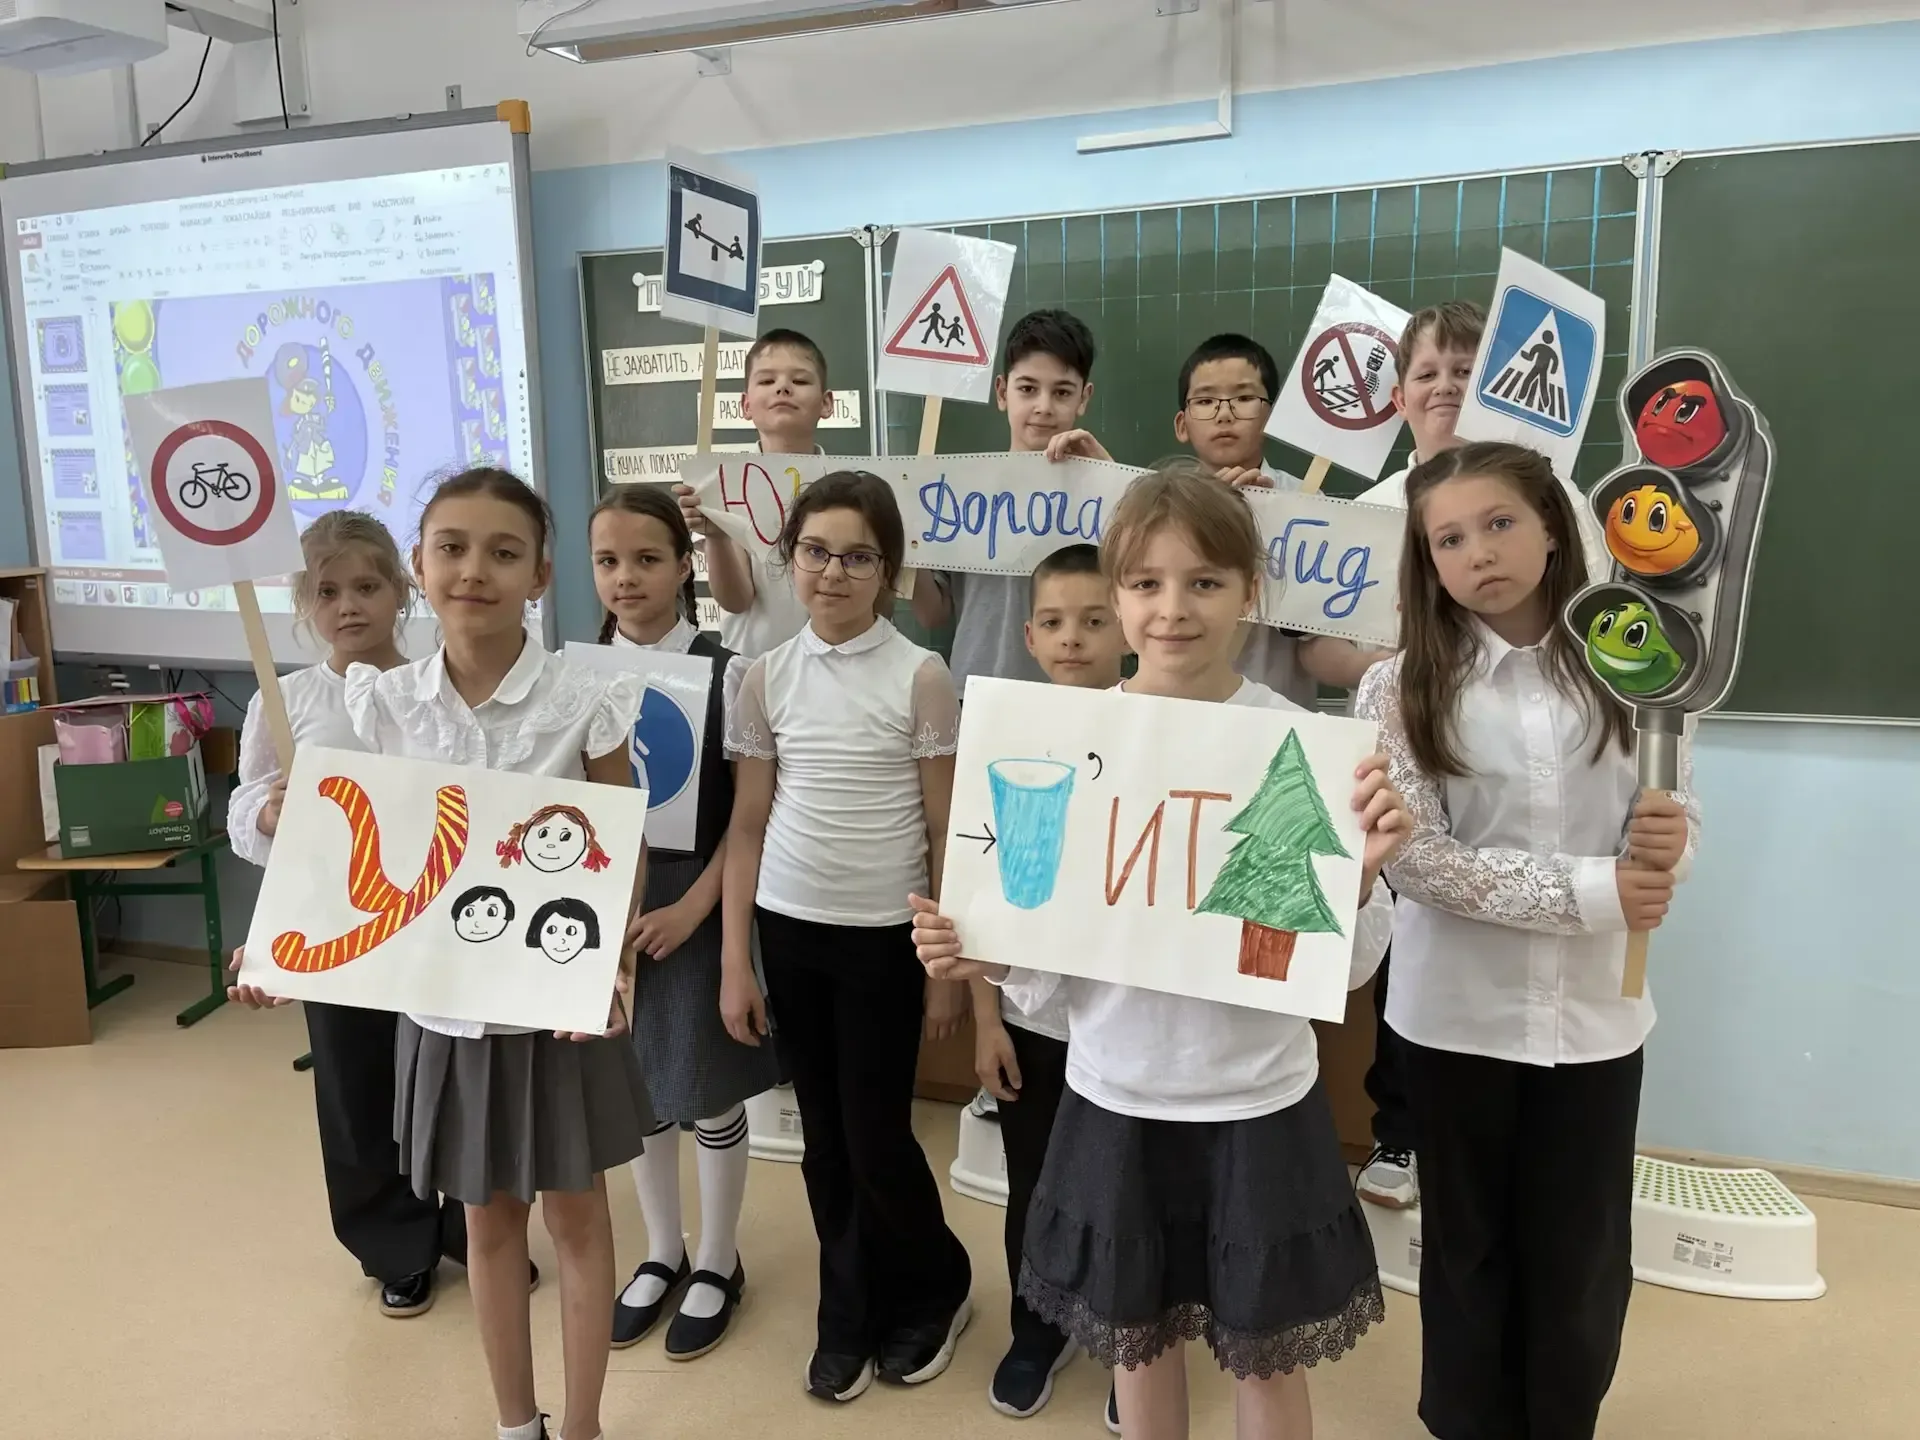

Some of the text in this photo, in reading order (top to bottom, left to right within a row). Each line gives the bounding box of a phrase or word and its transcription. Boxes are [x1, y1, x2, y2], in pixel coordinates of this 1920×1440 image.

[236, 296, 354, 369] ДОРОЖНОГО
[646, 265, 814, 306] ПБУЙ
[606, 356, 621, 377] НЕ
[717, 349, 748, 371] ТДАТ
[356, 342, 400, 507] ДВИЖЕНИЯ
[606, 455, 616, 476] НЕ
[617, 454, 645, 476] КУЛАК
[919, 473, 1379, 619] Дорога бид
[271, 776, 469, 973] У
[1104, 789, 1233, 910] ИТ
